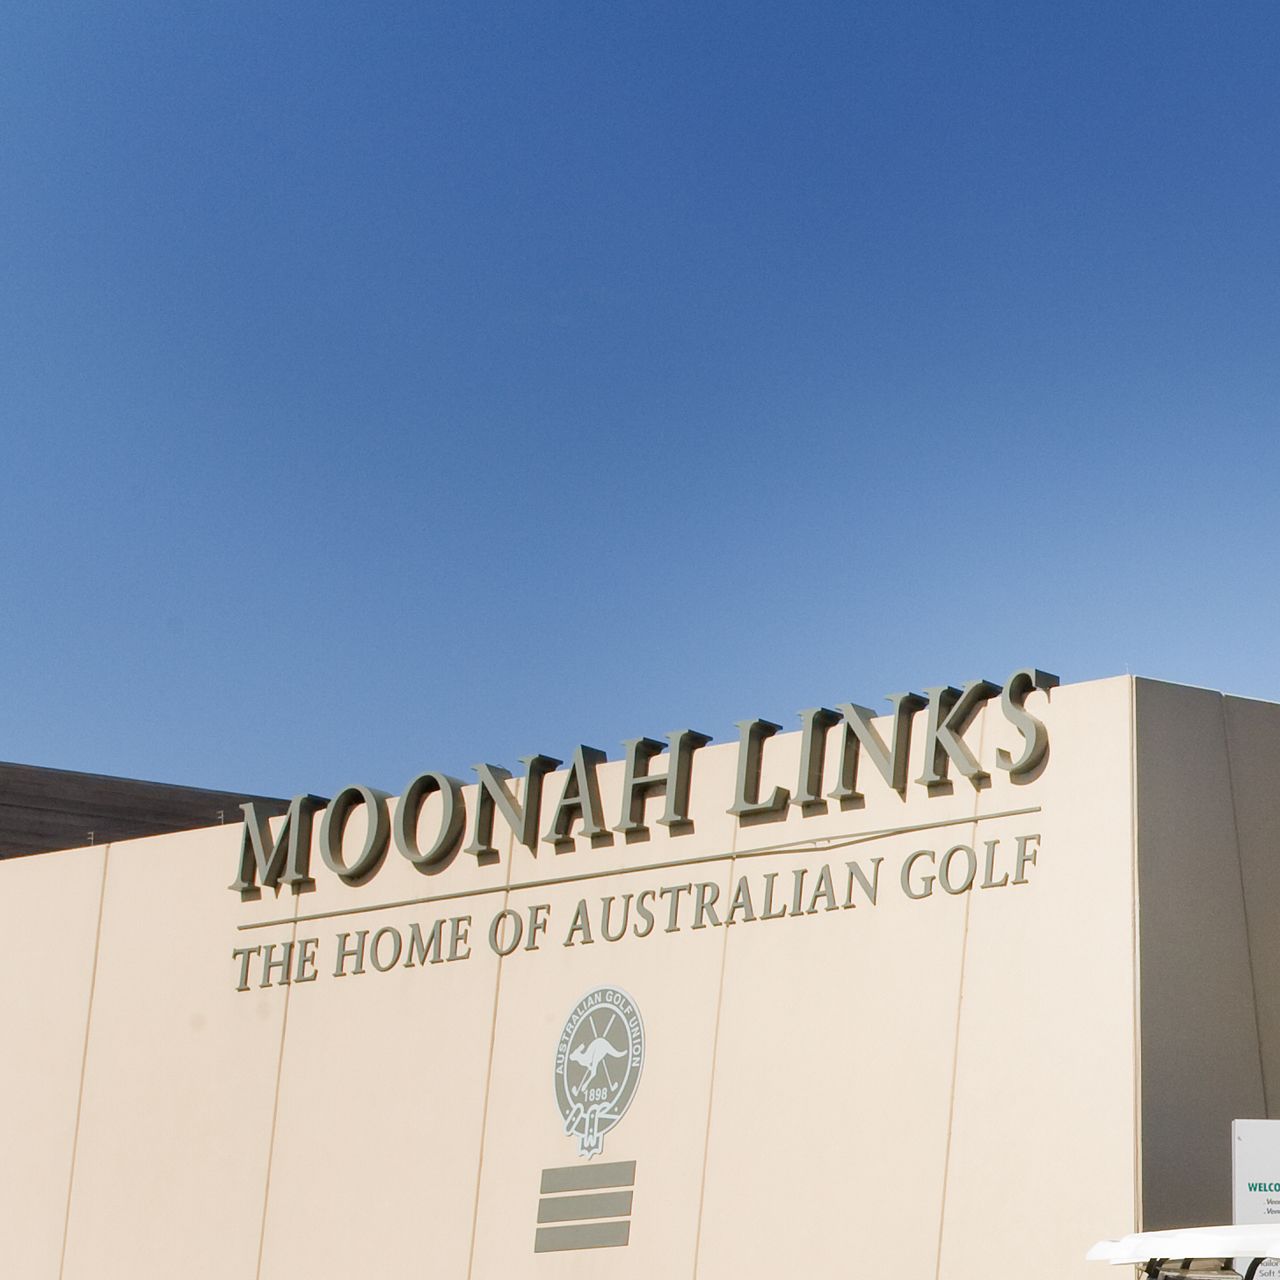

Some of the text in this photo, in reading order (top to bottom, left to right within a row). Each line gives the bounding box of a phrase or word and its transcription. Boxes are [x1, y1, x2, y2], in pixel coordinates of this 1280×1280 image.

[228, 668, 1060, 901] MOONAH LINKS
[232, 834, 1041, 992] THE HOME OF AUSTRALIAN GOLF
[556, 990, 640, 1075] AUSTRALIAN GOLF UNION
[583, 1087, 608, 1102] 1898
